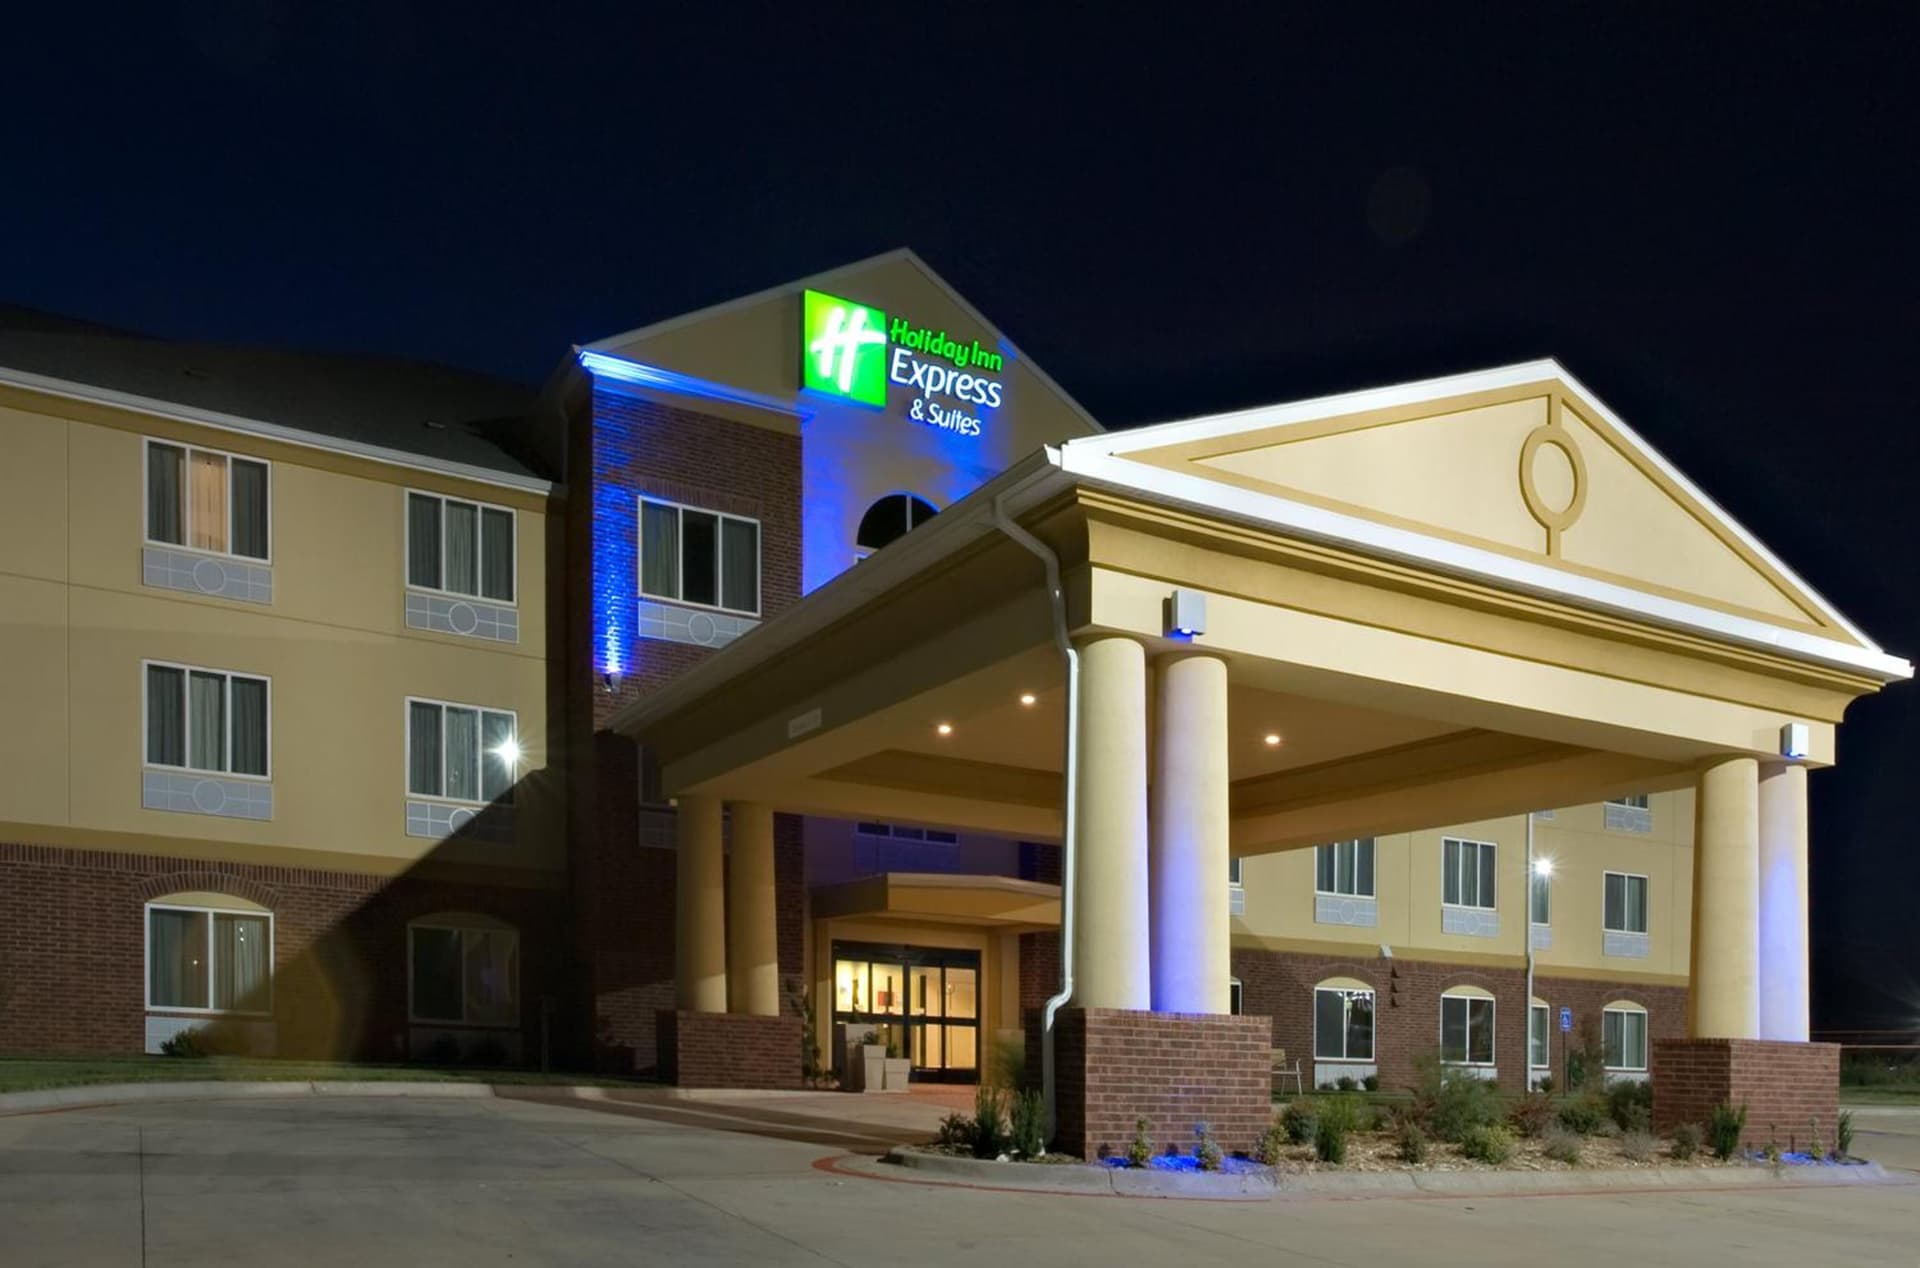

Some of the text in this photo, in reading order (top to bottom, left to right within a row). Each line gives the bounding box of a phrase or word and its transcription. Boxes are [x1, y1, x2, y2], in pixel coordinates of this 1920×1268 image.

[890, 318, 1002, 371] Holiday Inn
[891, 347, 1002, 408] Express
[910, 398, 982, 436] & Suites
